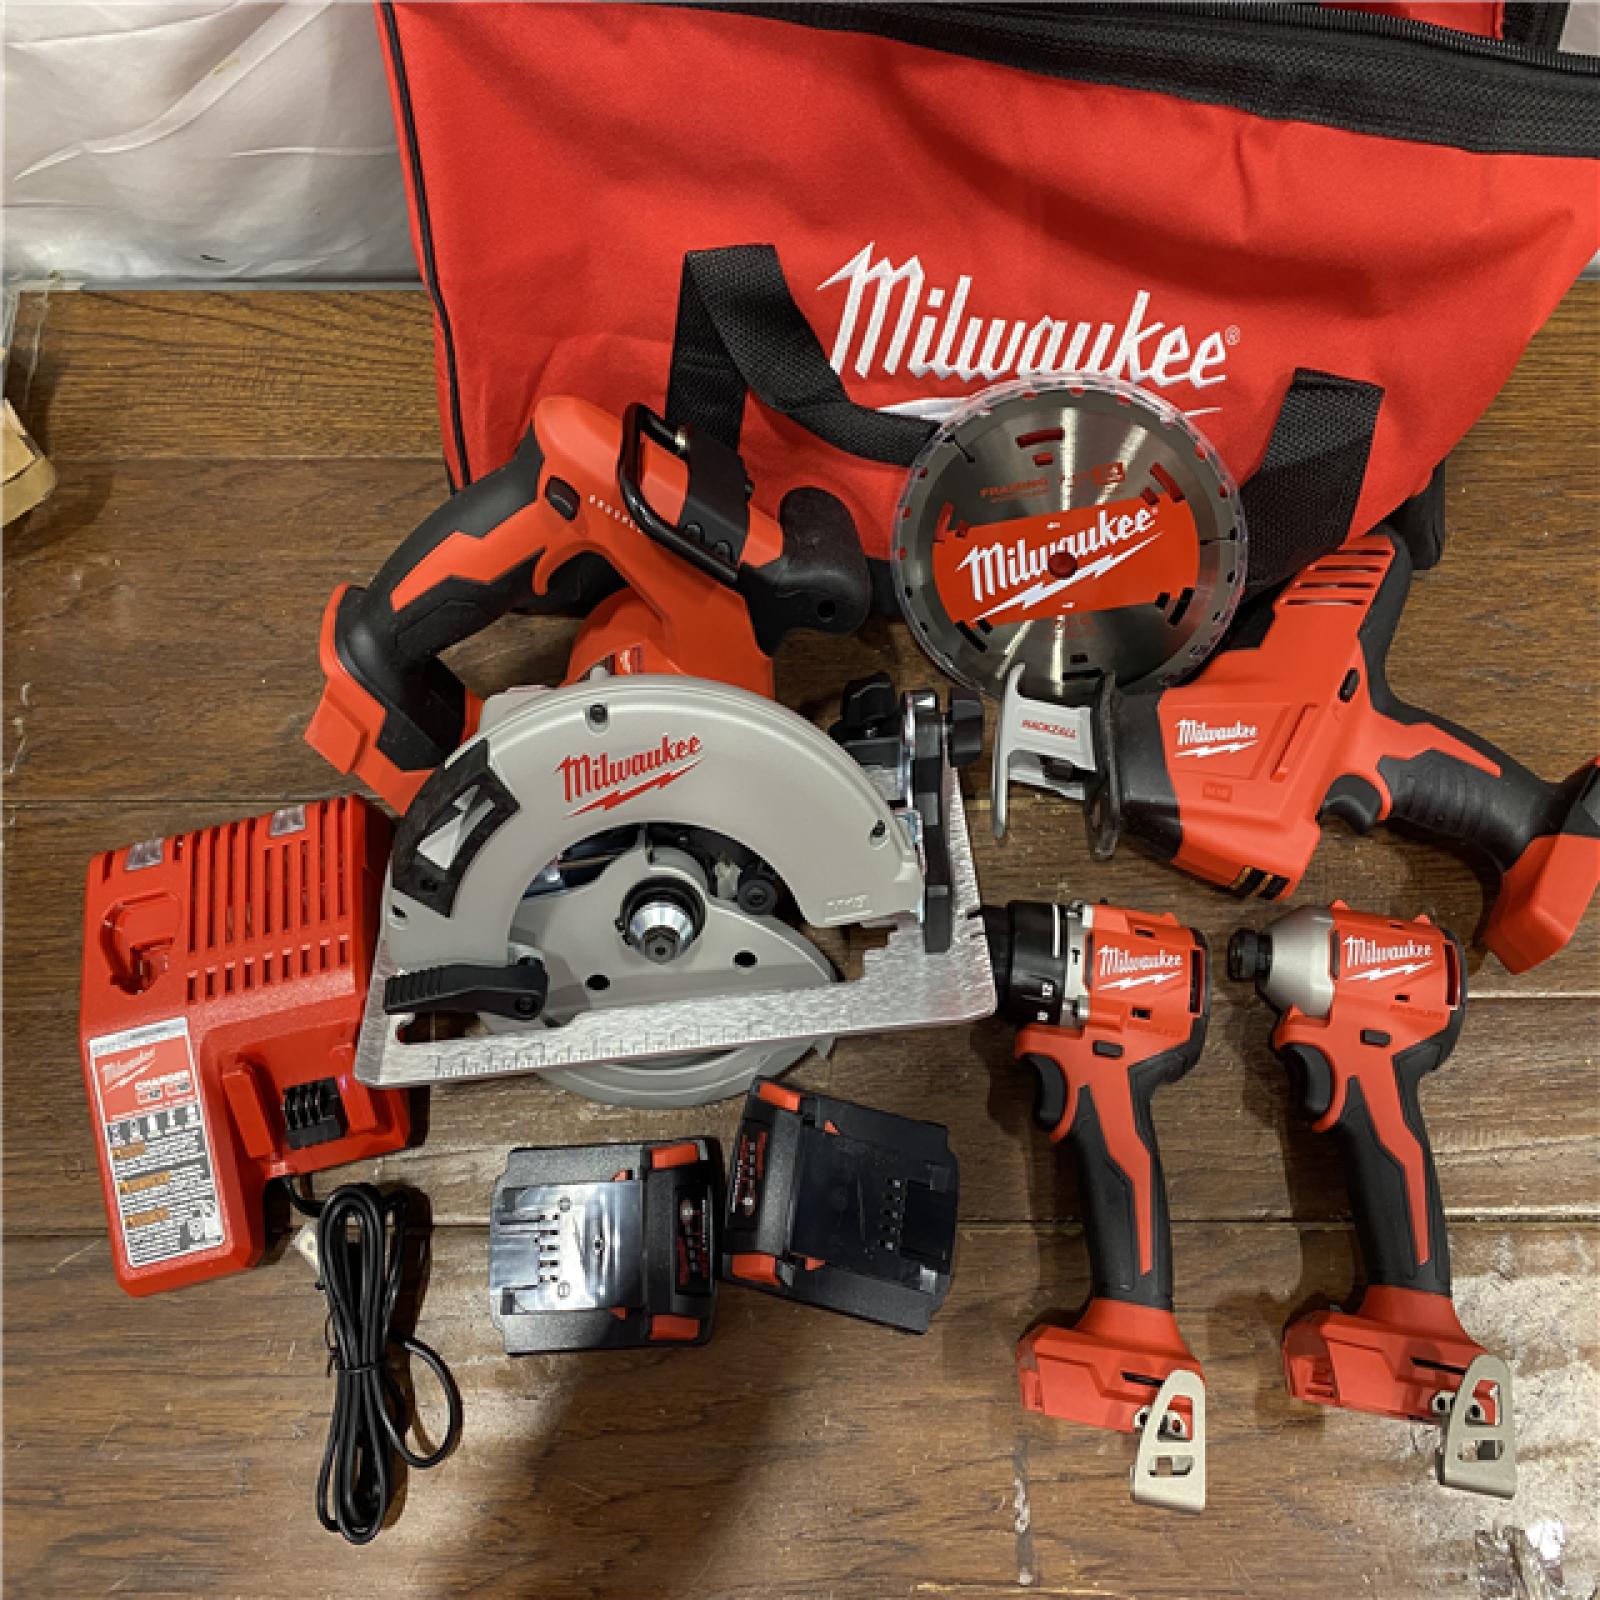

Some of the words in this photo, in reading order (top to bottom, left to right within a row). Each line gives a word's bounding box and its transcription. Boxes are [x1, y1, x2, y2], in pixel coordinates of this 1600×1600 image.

[817, 241, 1227, 388] Milwaukee
[1174, 719, 1258, 746] Milwaukee
[553, 734, 703, 802] Milwaukee
[1097, 944, 1183, 976] Milwaukee
[1343, 935, 1433, 968] Milwaukee
